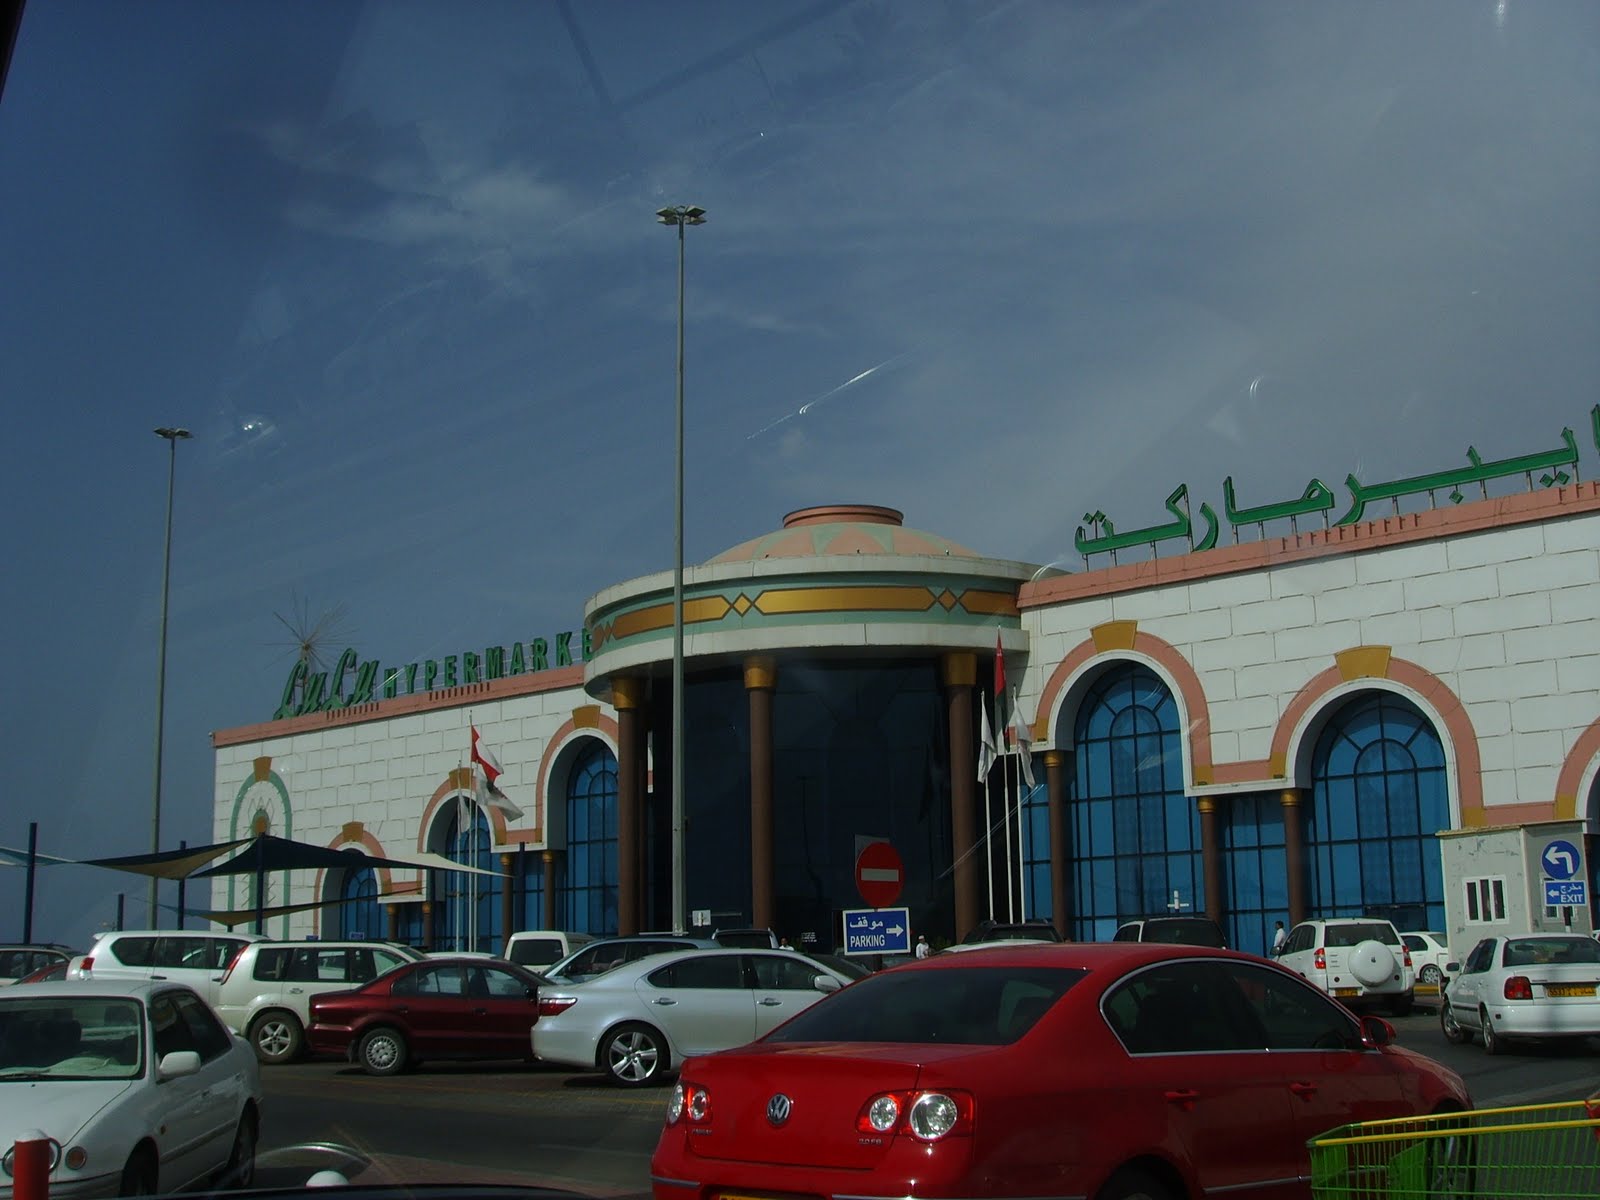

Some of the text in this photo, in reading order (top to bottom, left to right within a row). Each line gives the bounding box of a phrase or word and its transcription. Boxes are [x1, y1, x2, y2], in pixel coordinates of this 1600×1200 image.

[1560, 883, 1582, 894] مخرج
[1560, 893, 1583, 903] EXIT
[849, 916, 884, 930] موقف
[850, 934, 885, 948] PARKING
